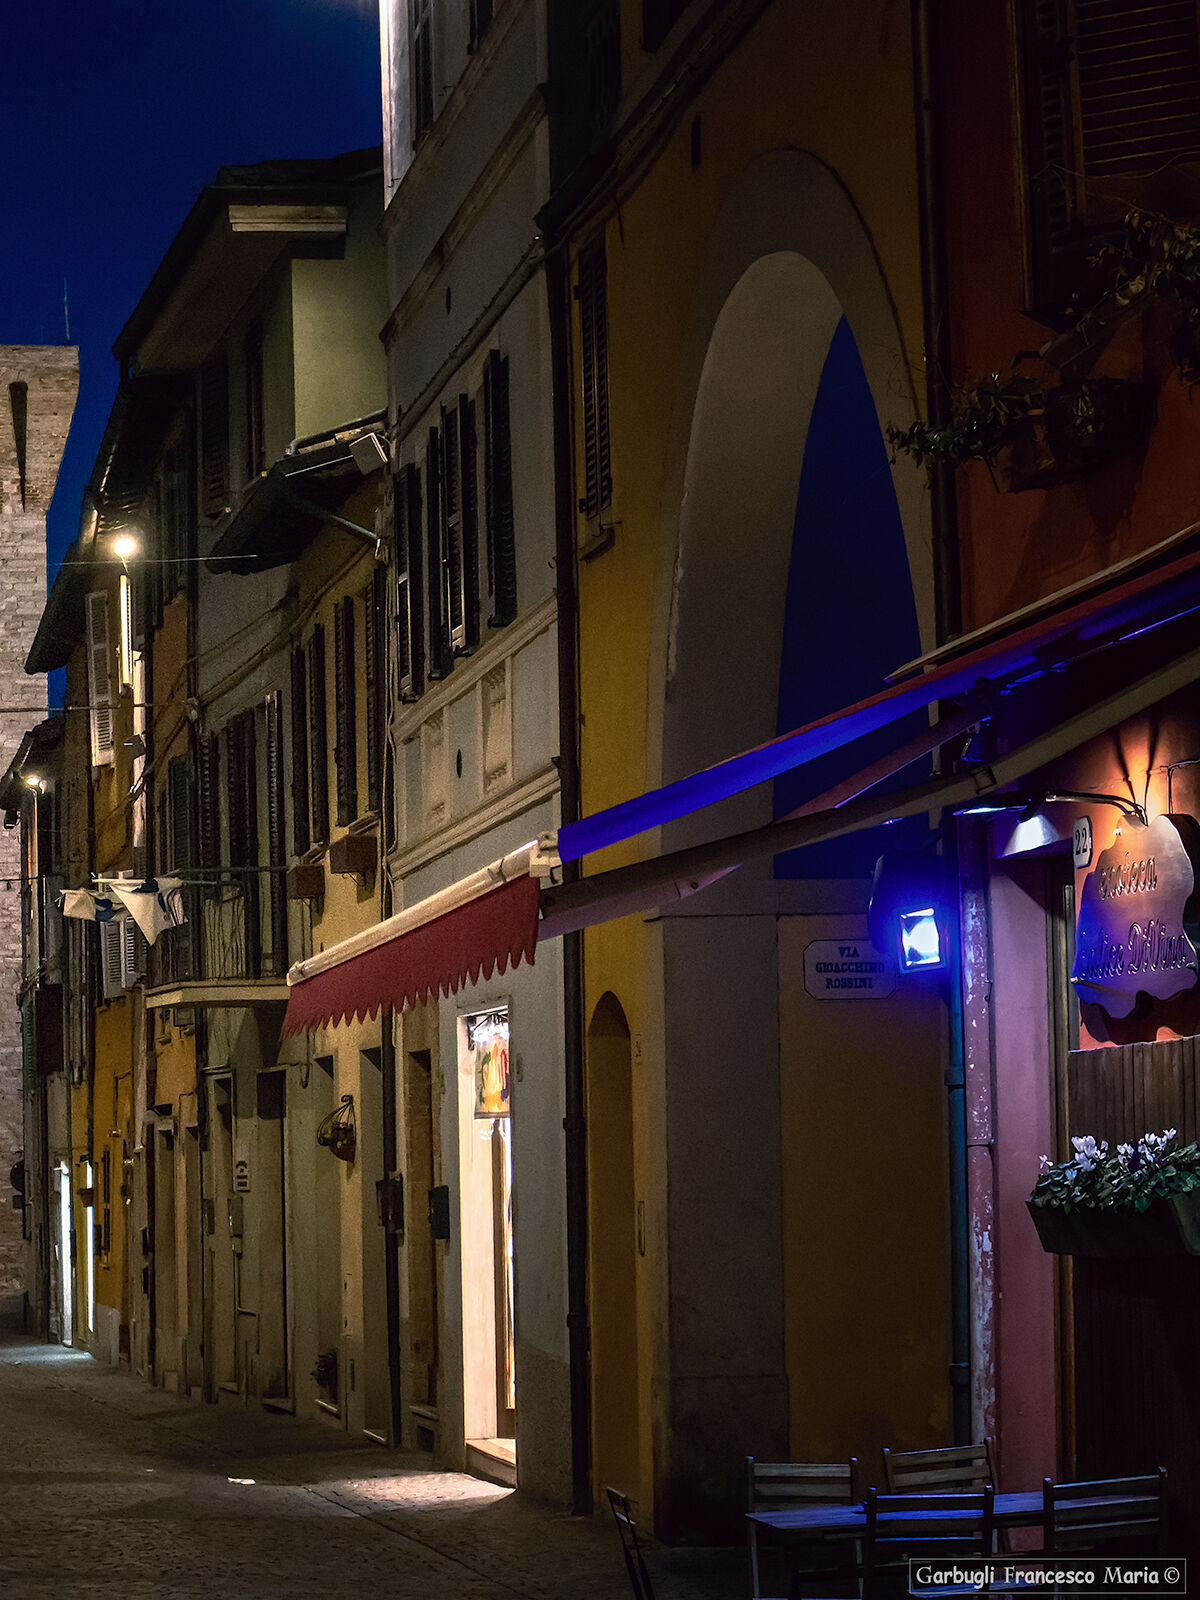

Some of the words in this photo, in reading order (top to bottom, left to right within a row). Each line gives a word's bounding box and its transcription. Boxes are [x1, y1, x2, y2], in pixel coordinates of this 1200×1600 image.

[1075, 827, 1088, 856] 22
[838, 946, 860, 958] VIA
[815, 962, 885, 973] GIOACCHINO
[825, 977, 873, 989] ROSSINI
